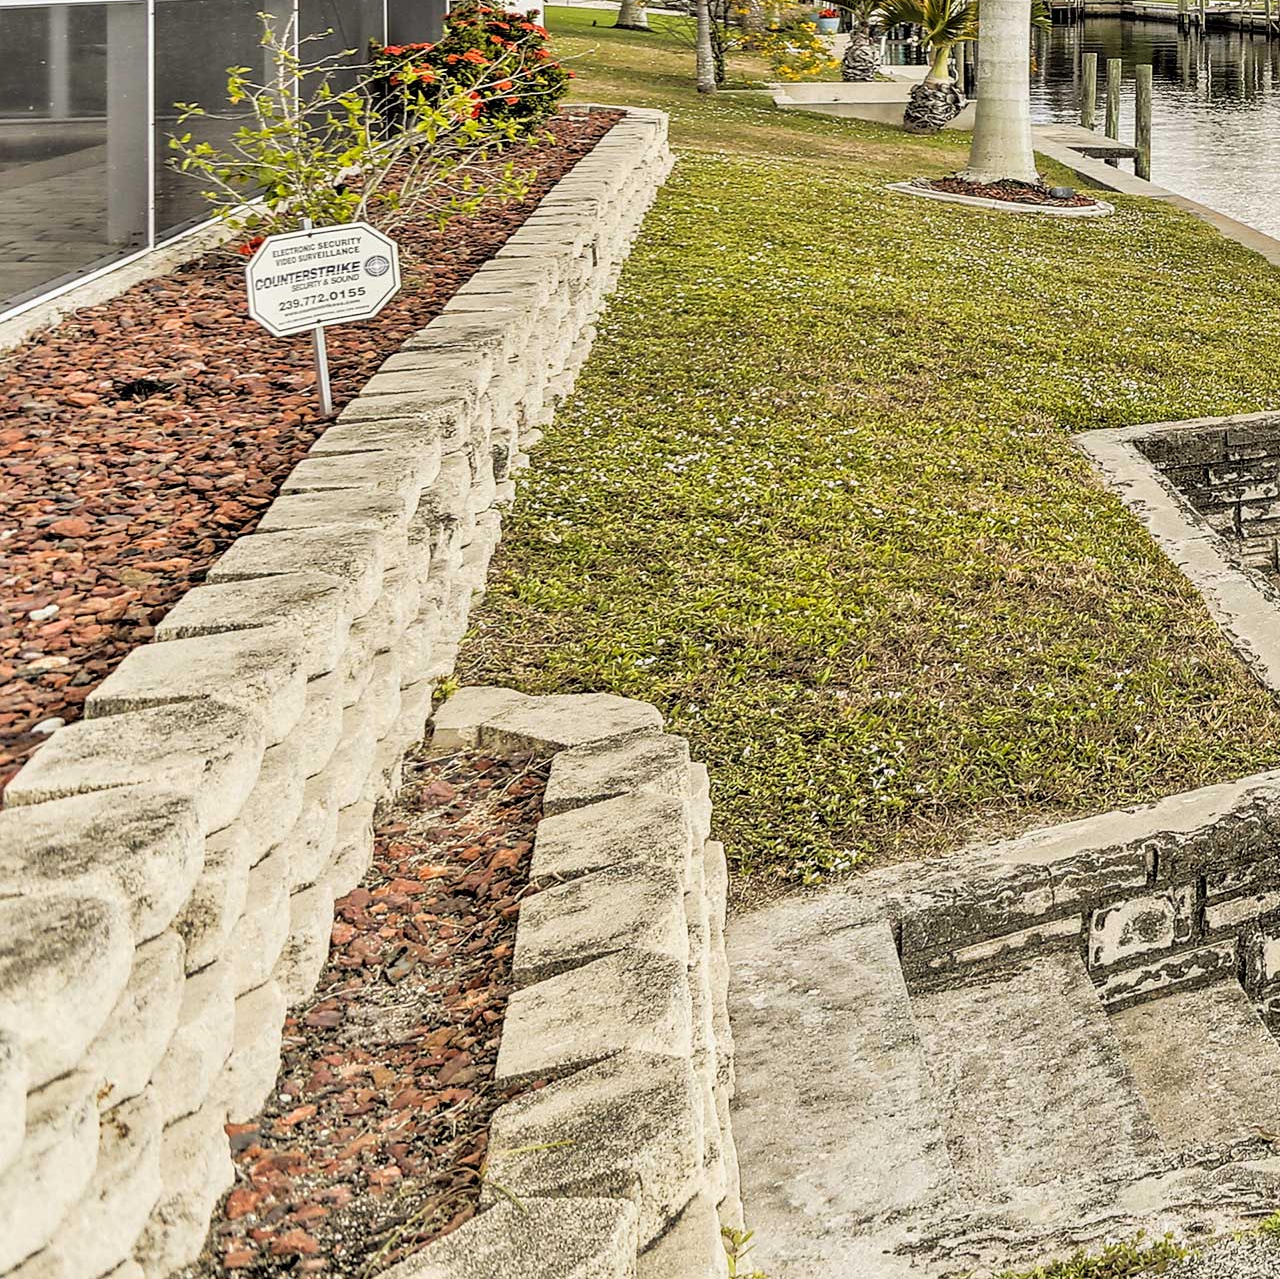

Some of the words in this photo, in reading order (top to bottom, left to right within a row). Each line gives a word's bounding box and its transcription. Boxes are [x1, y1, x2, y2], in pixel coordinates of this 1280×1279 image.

[272, 243, 315, 258] ELECTRONIC
[318, 237, 362, 249] SECURITY
[275, 257, 296, 267] VIDEO
[298, 246, 360, 262] SURVEILLANCE
[255, 261, 361, 291] COUNTERSTRIKE
[291, 279, 321, 292] SECURITY
[323, 278, 329, 286] &
[330, 273, 360, 285] SOUND
[279, 286, 366, 312] 239.772.0155
